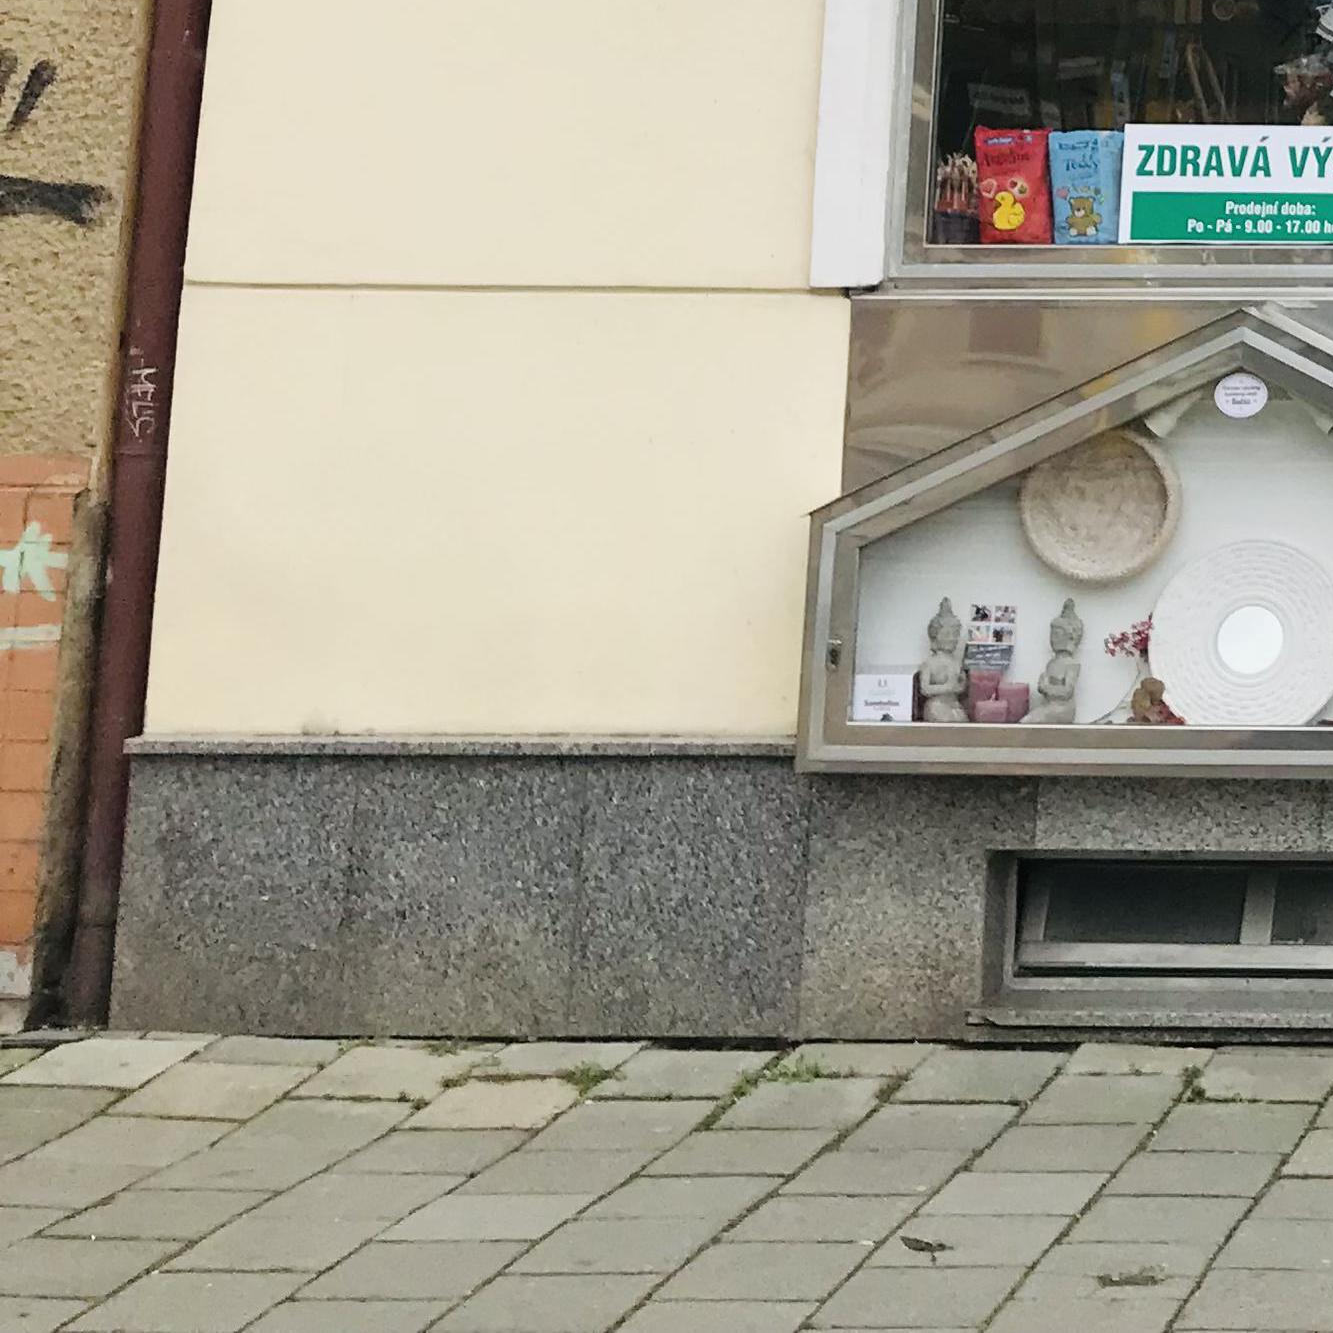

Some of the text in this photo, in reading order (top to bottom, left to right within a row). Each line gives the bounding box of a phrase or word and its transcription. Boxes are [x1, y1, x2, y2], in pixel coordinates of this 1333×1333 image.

[1135, 136, 1272, 177] ZDRAVÁ
[1225, 200, 1316, 218] Prodejní doba:
[1187, 218, 1204, 233] Po
[1215, 218, 1233, 233] Pá
[1244, 219, 1273, 234] 9.00
[1285, 219, 1321, 234] 17.00
